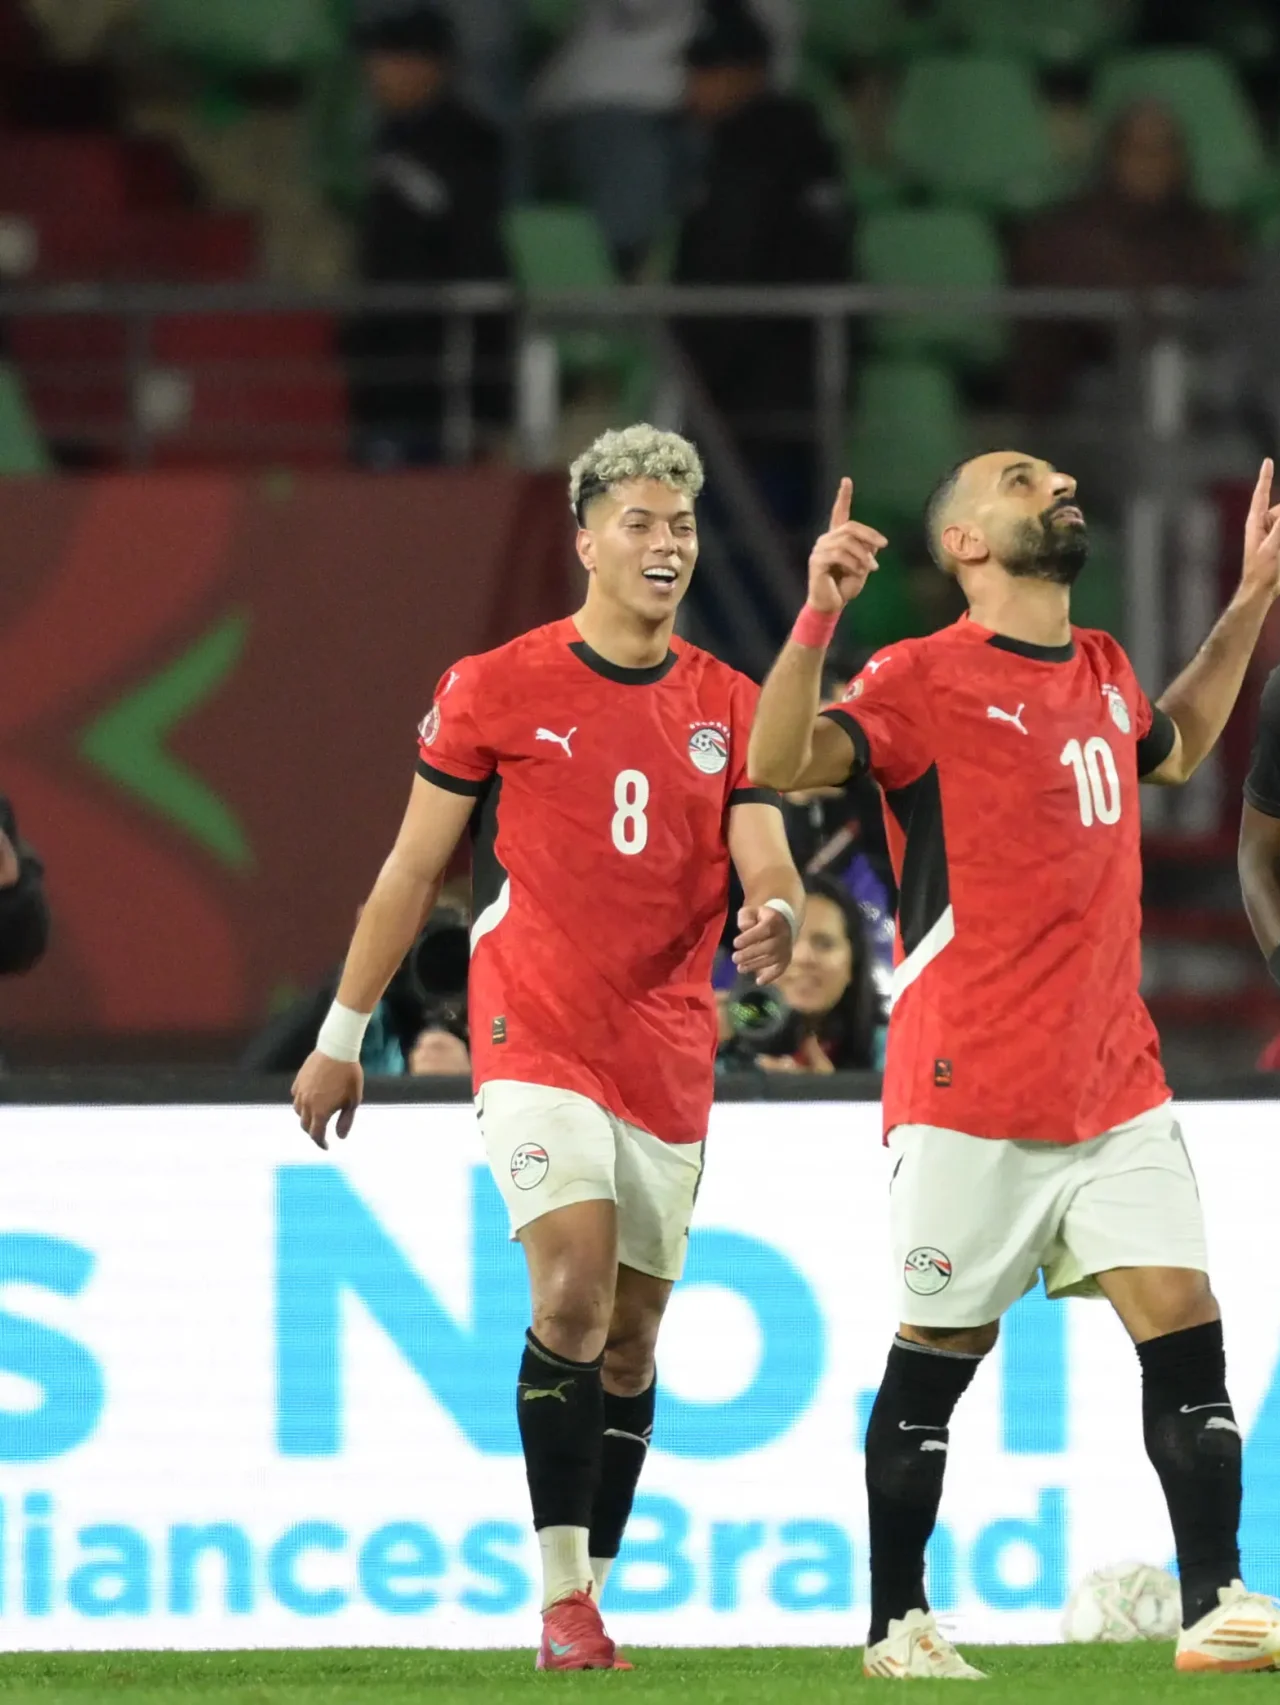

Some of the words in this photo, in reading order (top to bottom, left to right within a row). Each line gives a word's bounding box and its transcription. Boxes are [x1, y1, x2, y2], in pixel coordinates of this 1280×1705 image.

[611, 769, 650, 855] 8
[1060, 736, 1122, 827] 10
[0, 1488, 533, 1618] iances
